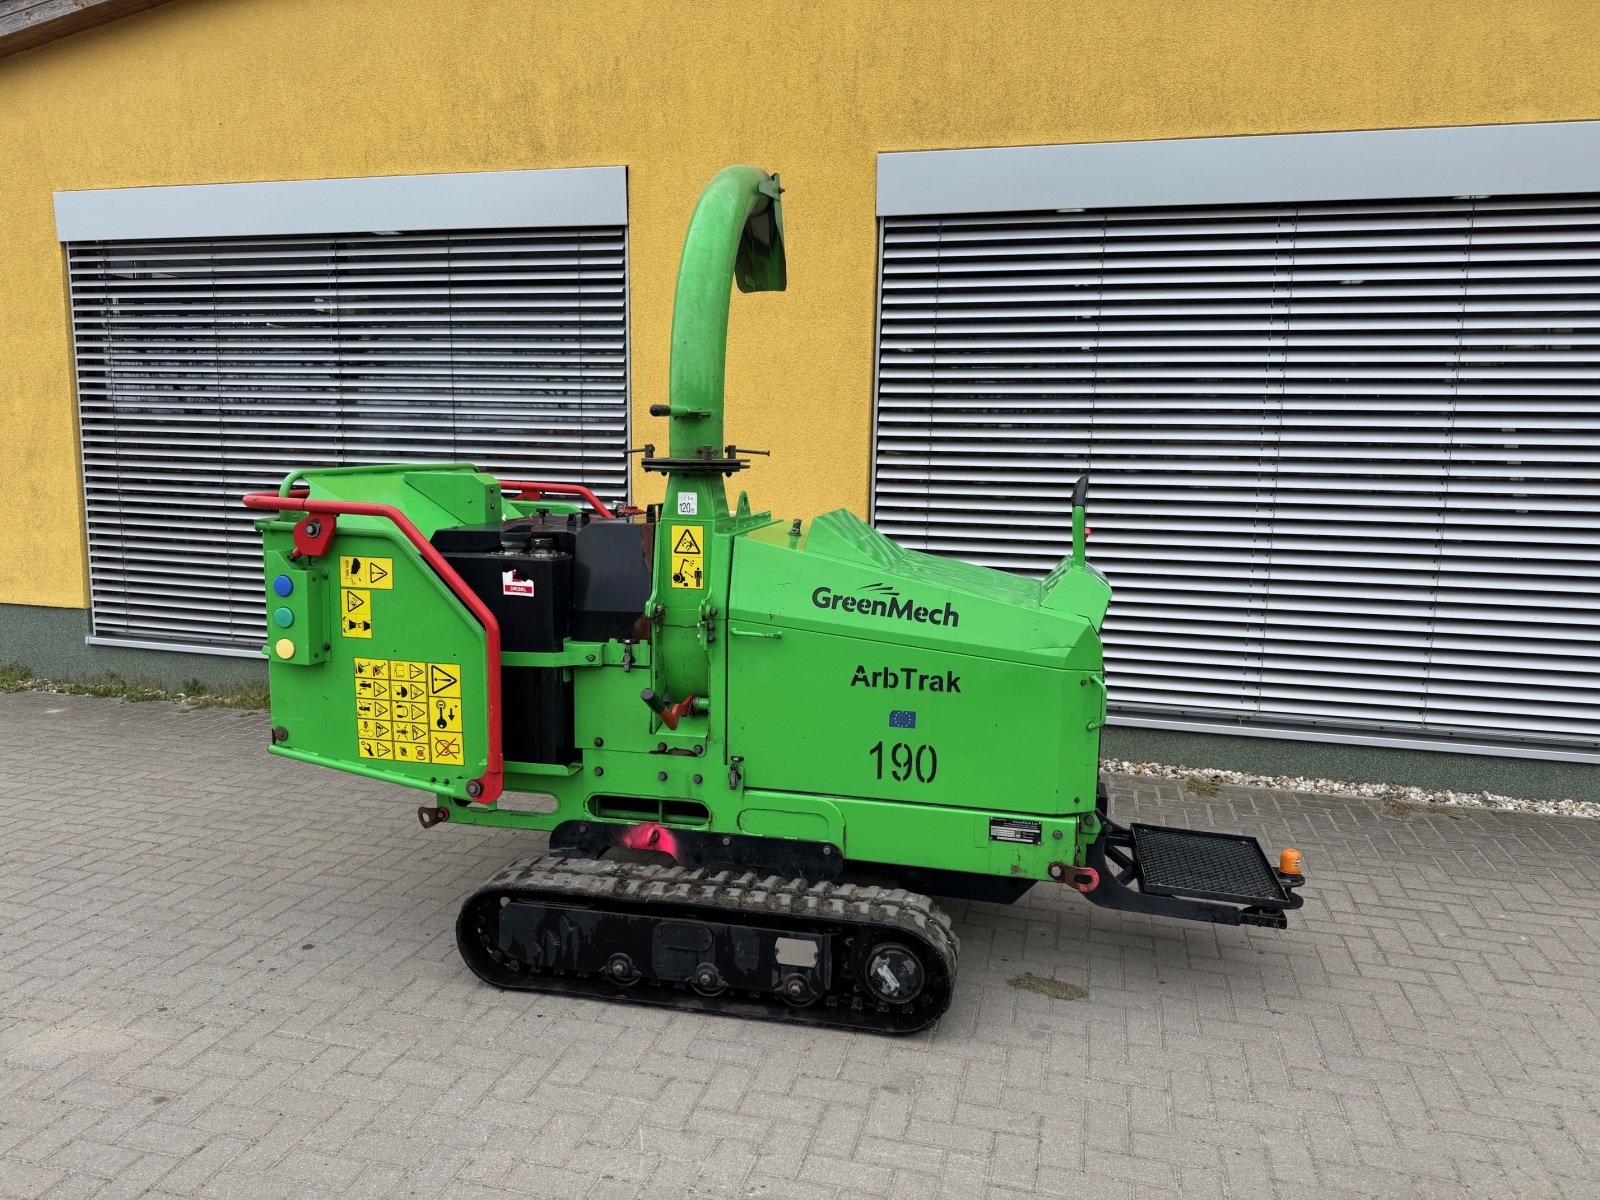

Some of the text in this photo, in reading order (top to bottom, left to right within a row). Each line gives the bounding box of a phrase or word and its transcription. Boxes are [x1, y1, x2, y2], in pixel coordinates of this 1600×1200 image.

[679, 502, 691, 513] 120
[812, 586, 959, 627] GreenMech
[850, 665, 962, 693] ArbTrak
[869, 741, 938, 784] 190
